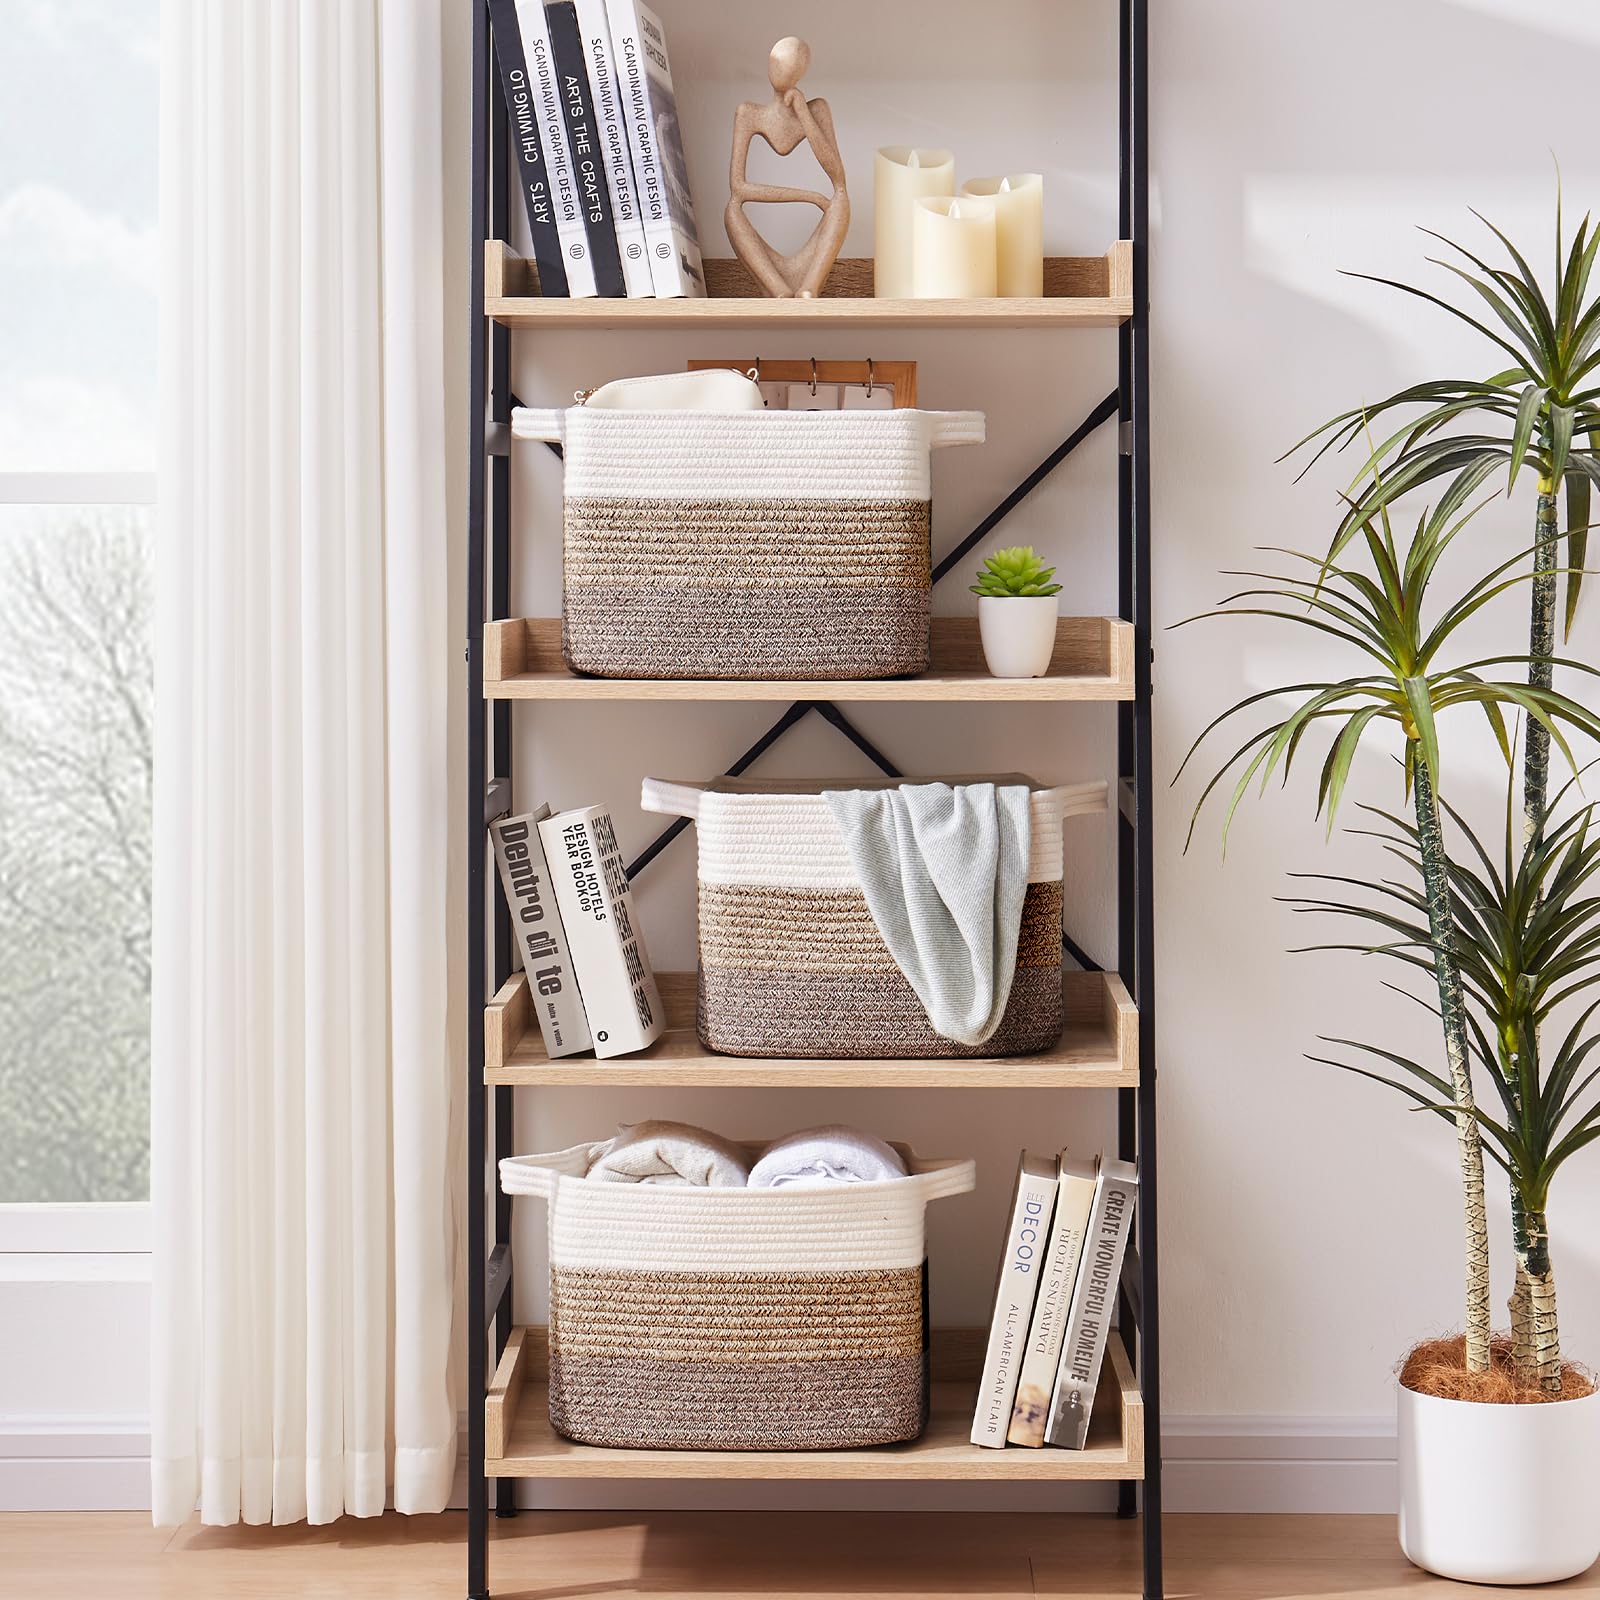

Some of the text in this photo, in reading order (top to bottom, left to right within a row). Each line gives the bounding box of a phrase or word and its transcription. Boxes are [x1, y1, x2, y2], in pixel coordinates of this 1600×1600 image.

[509, 69, 550, 224] ARTS CHI WING LO
[533, 39, 575, 221] SCANDINAVIAV GRAPHIC DESIGN
[565, 75, 603, 224] ARTS THE CRAFTS
[592, 39, 633, 221] SCANDINAVIAV GRAPHIC DESIGN
[622, 37, 662, 220] SCANDINAVIAV GRAPHIC DESIGN
[499, 821, 544, 924] Dentro
[562, 825, 579, 859] YEAR
[573, 823, 606, 921] DESIGN HOTELS
[526, 931, 559, 960] di
[536, 965, 562, 996] te
[1014, 1201, 1041, 1273] DECOR
[1035, 1227, 1071, 1353] DARWINS TEORI
[1071, 1190, 1127, 1383] CREATE WONDERFUL HOMELIFE
[986, 1304, 1019, 1434] ALL-AMERICAN FLAIR
